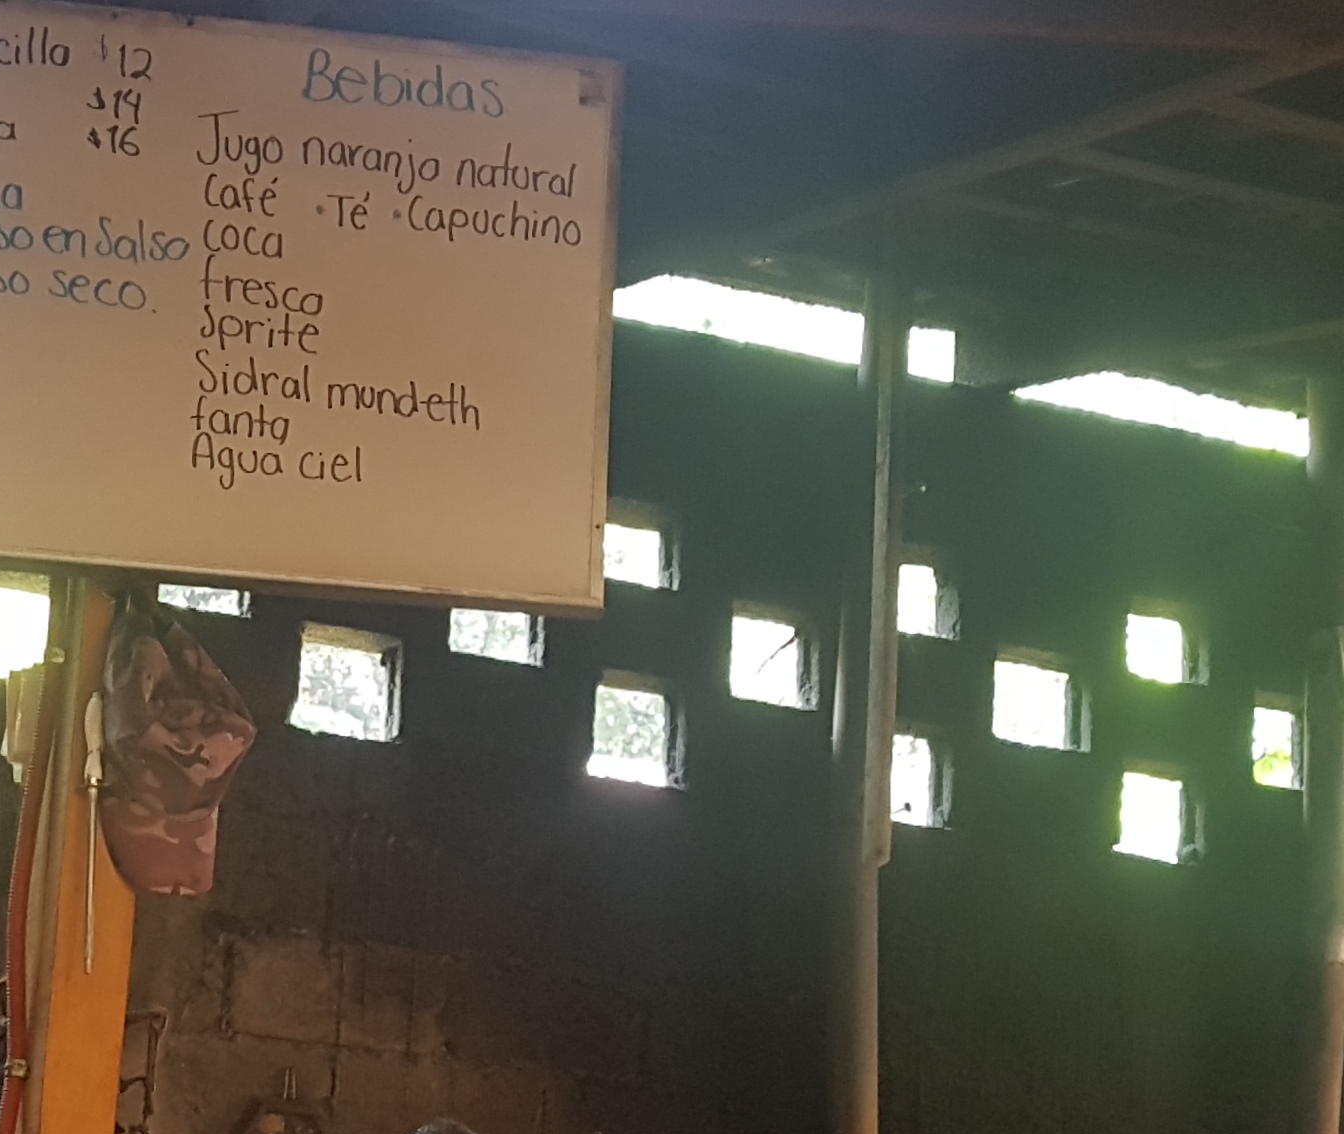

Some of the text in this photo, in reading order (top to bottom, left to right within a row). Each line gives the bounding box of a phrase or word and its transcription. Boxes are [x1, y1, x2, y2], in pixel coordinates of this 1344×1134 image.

[301, 47, 504, 117] Bebidas
[196, 110, 284, 175] Jugo
[457, 142, 576, 198] natural
[42, 223, 85, 258] en
[205, 173, 581, 247] Café Té Capuchino
[200, 305, 320, 354] Sprite
[195, 349, 480, 431] Sidral mundeth
[191, 432, 283, 490] Agua
